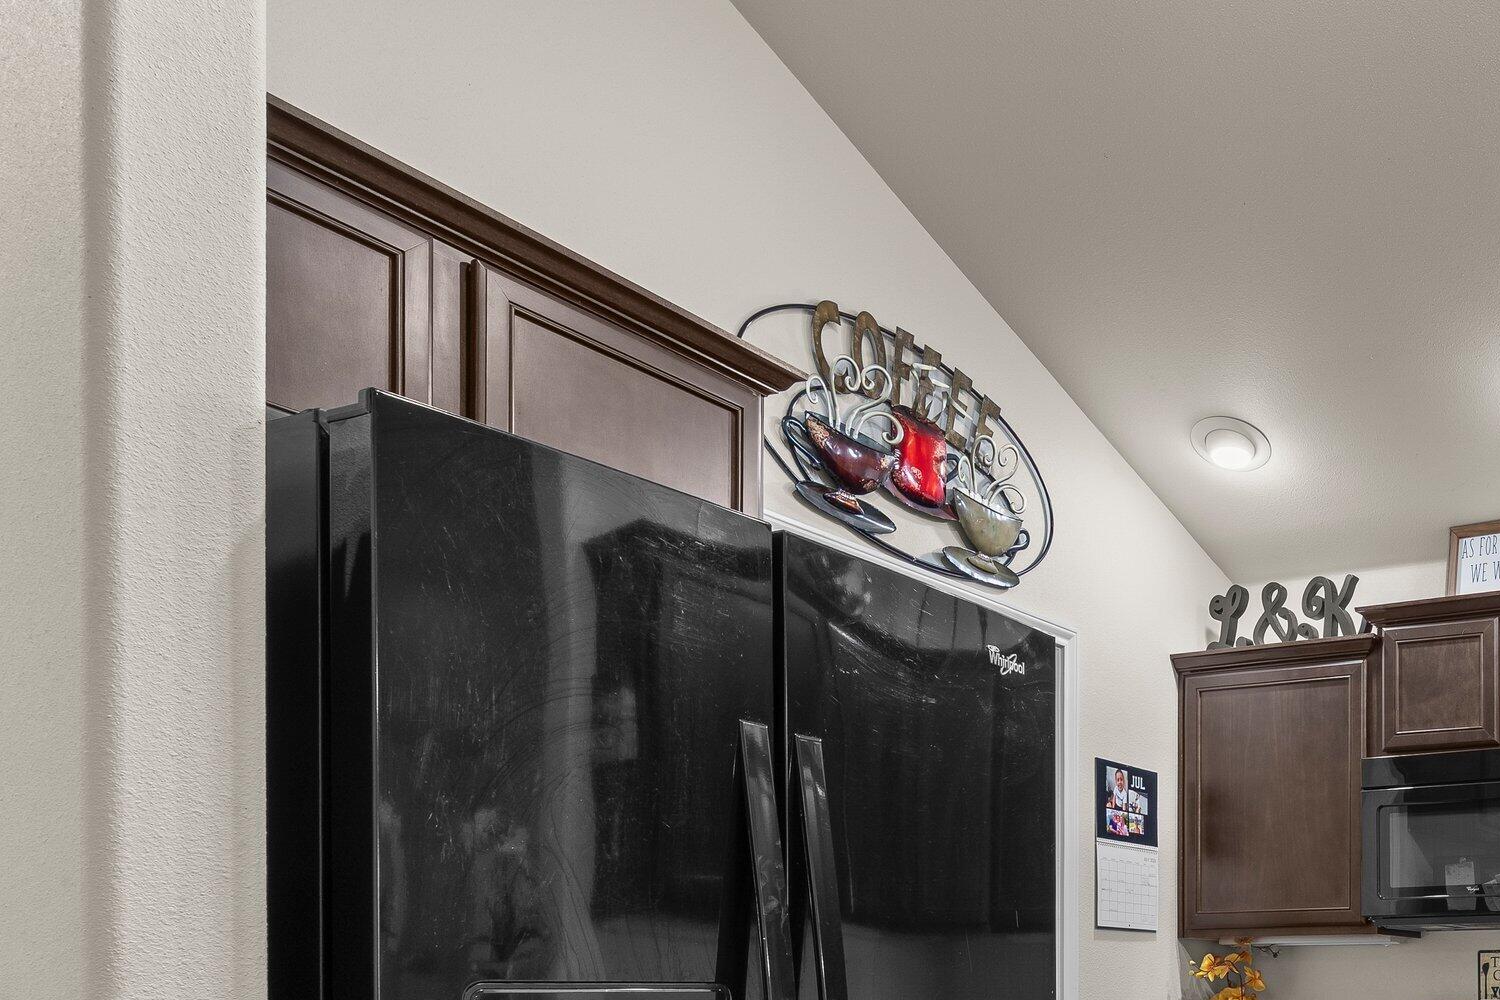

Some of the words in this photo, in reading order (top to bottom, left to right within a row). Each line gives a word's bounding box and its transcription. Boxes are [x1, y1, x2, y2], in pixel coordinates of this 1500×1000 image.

[811, 300, 1001, 463] COFFEE
[1462, 538, 1474, 559] AS
[1480, 535, 1498, 556] FOR
[1471, 562, 1488, 583] WE
[1253, 582, 1298, 644] &
[1298, 574, 1360, 639] K
[988, 648, 1026, 676] Whirlpool
[1130, 774, 1146, 791] JUL
